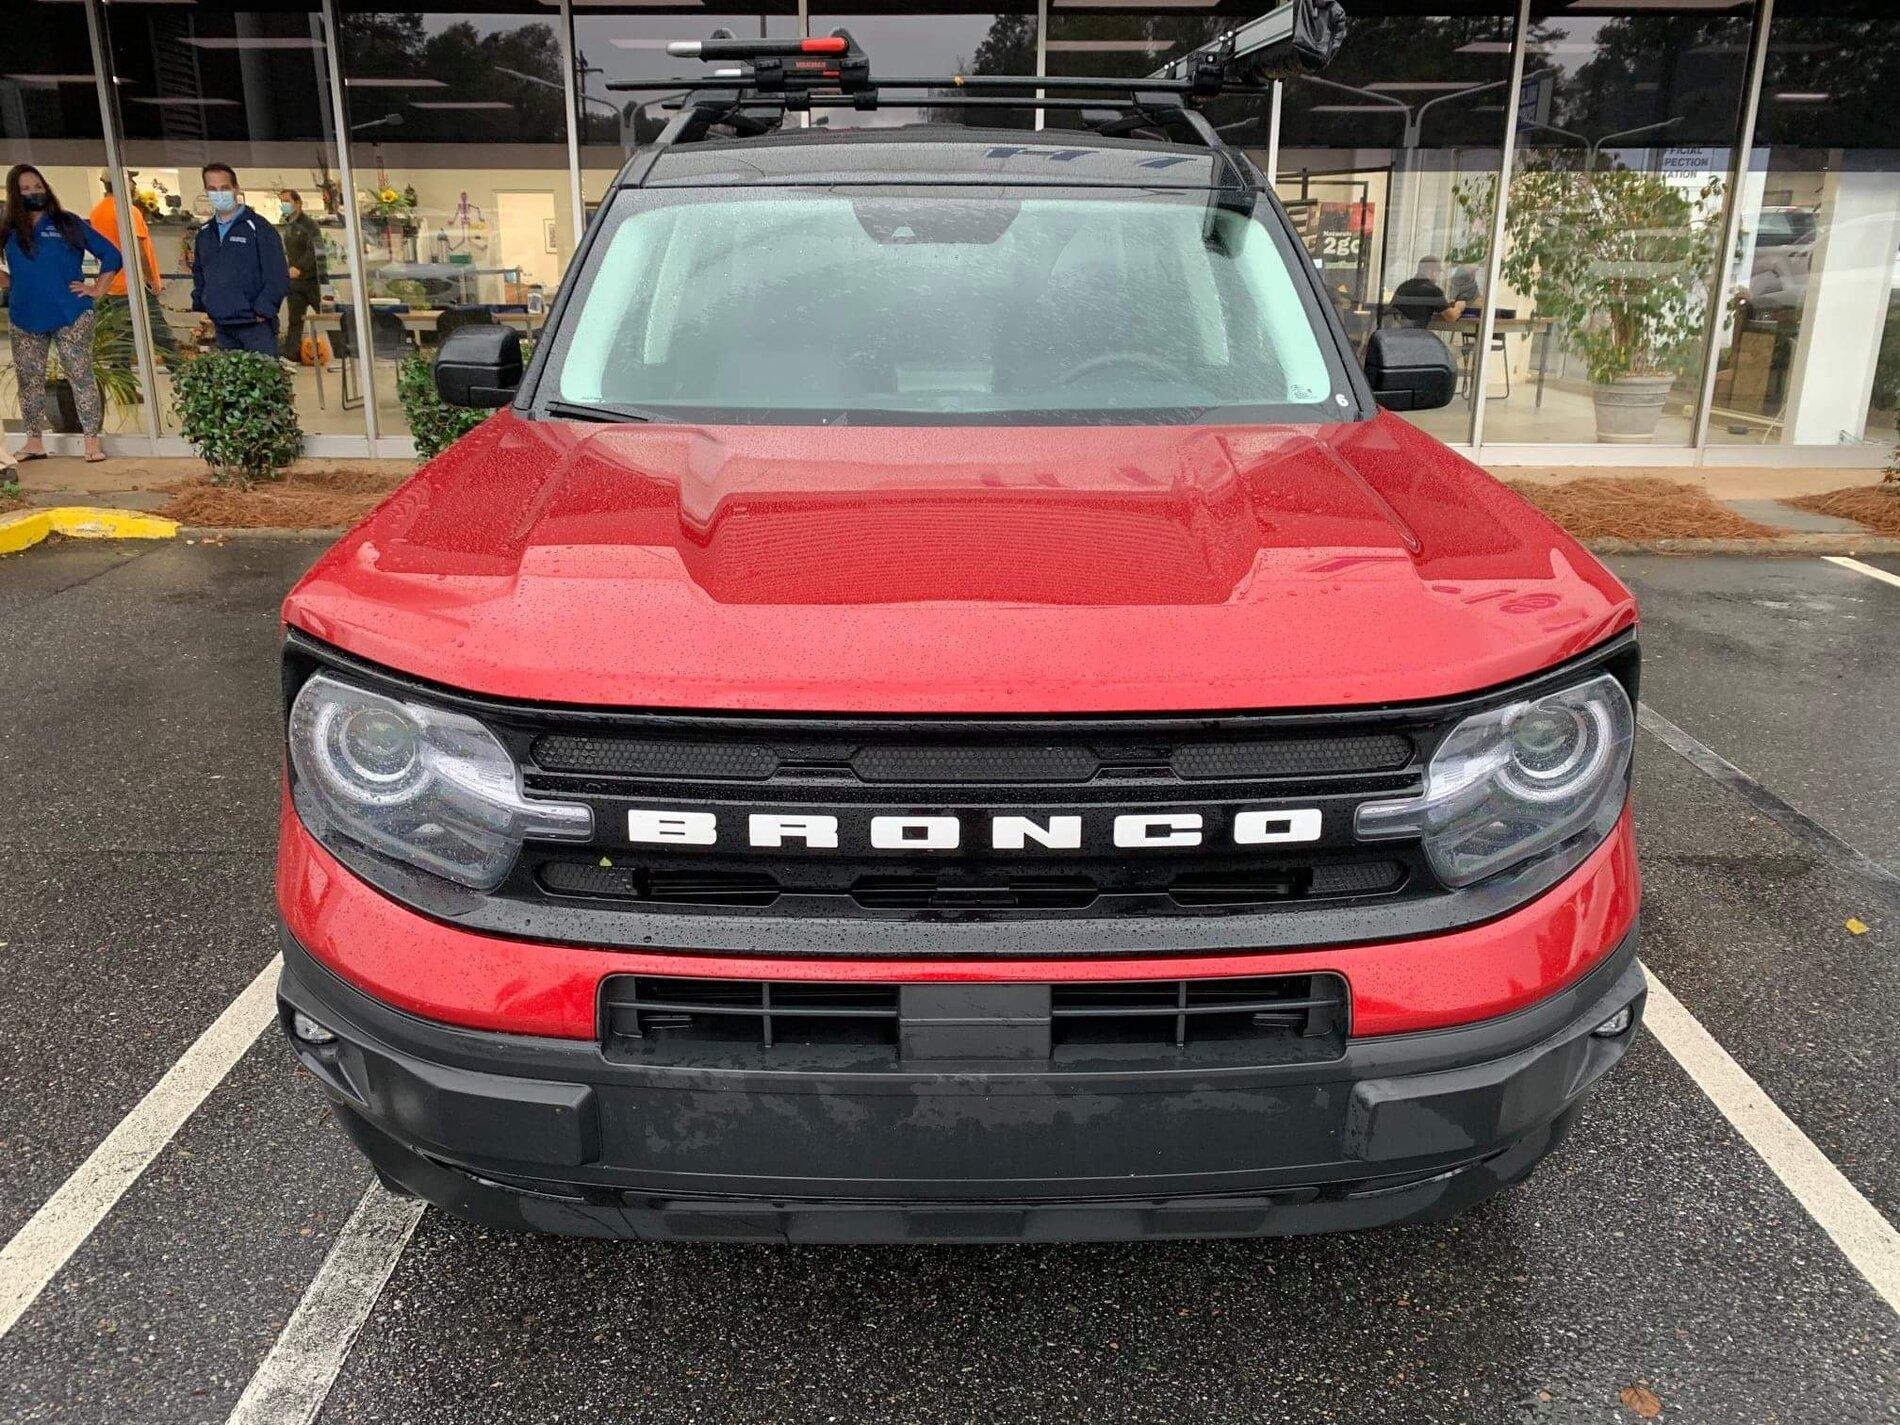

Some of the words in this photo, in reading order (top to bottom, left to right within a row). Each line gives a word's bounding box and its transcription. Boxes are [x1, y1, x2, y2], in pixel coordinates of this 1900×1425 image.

[1663, 147, 1703, 155] FFICIAL
[1664, 157, 1708, 167] PECTION
[1666, 169, 1697, 179] ATION
[629, 809, 1322, 848] BRONCO
